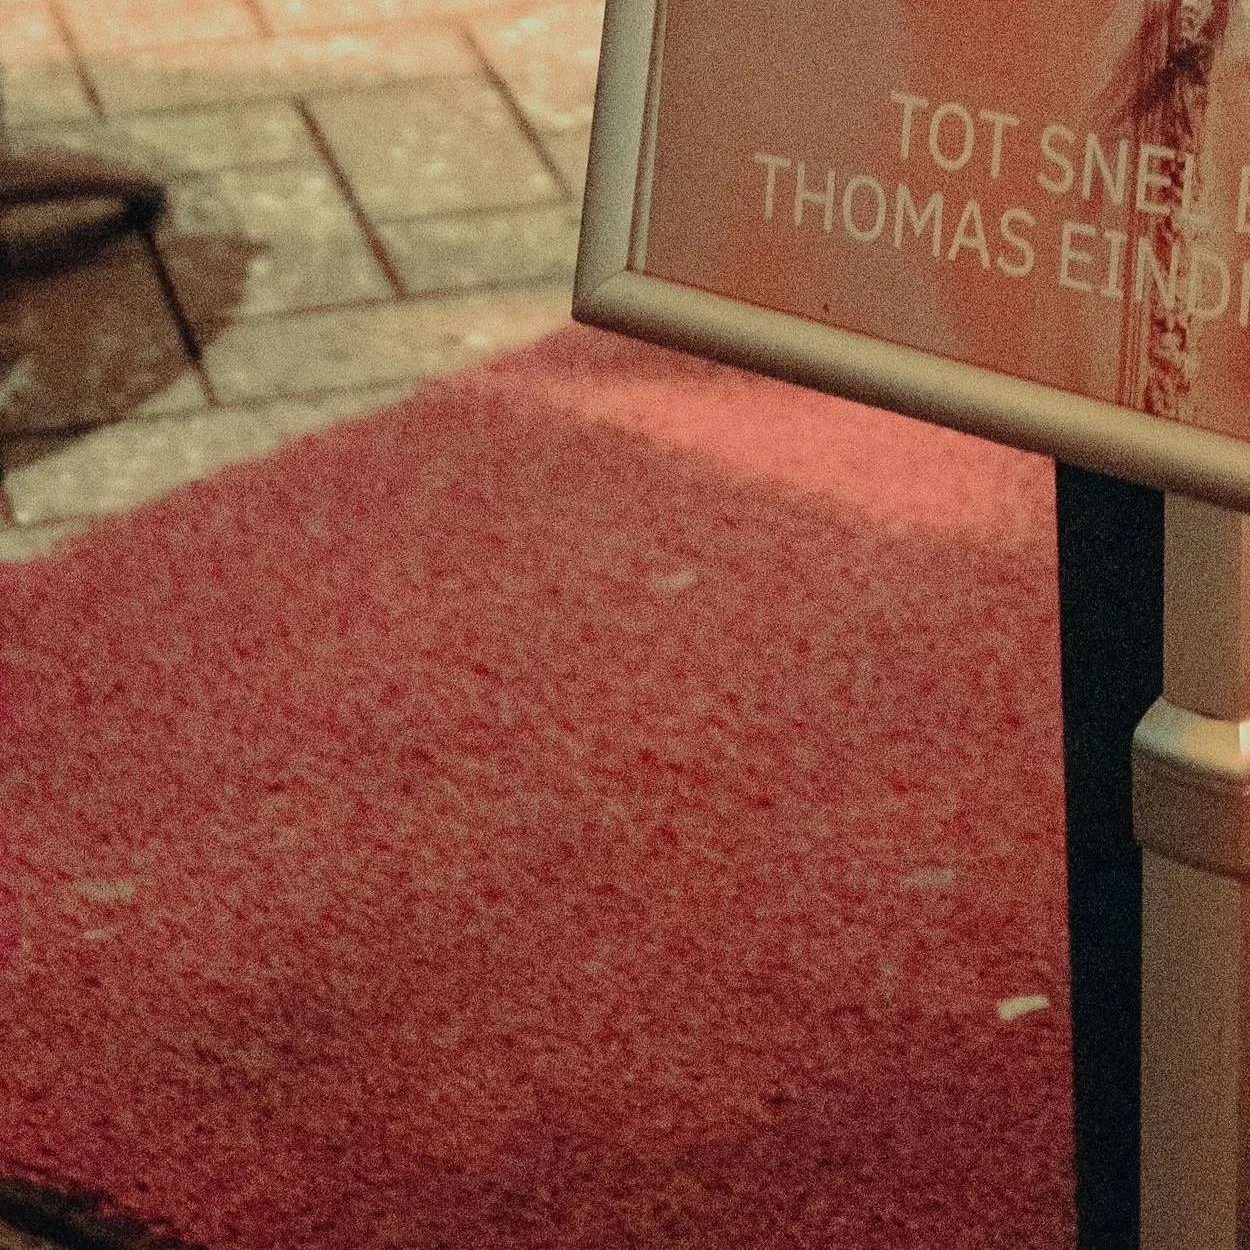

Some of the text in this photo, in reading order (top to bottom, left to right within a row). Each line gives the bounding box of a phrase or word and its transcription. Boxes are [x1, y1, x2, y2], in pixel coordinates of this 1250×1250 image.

[753, 153, 1036, 278] THOMAS
[890, 90, 1019, 179] TOT
[1038, 123, 1211, 226] SNEL
